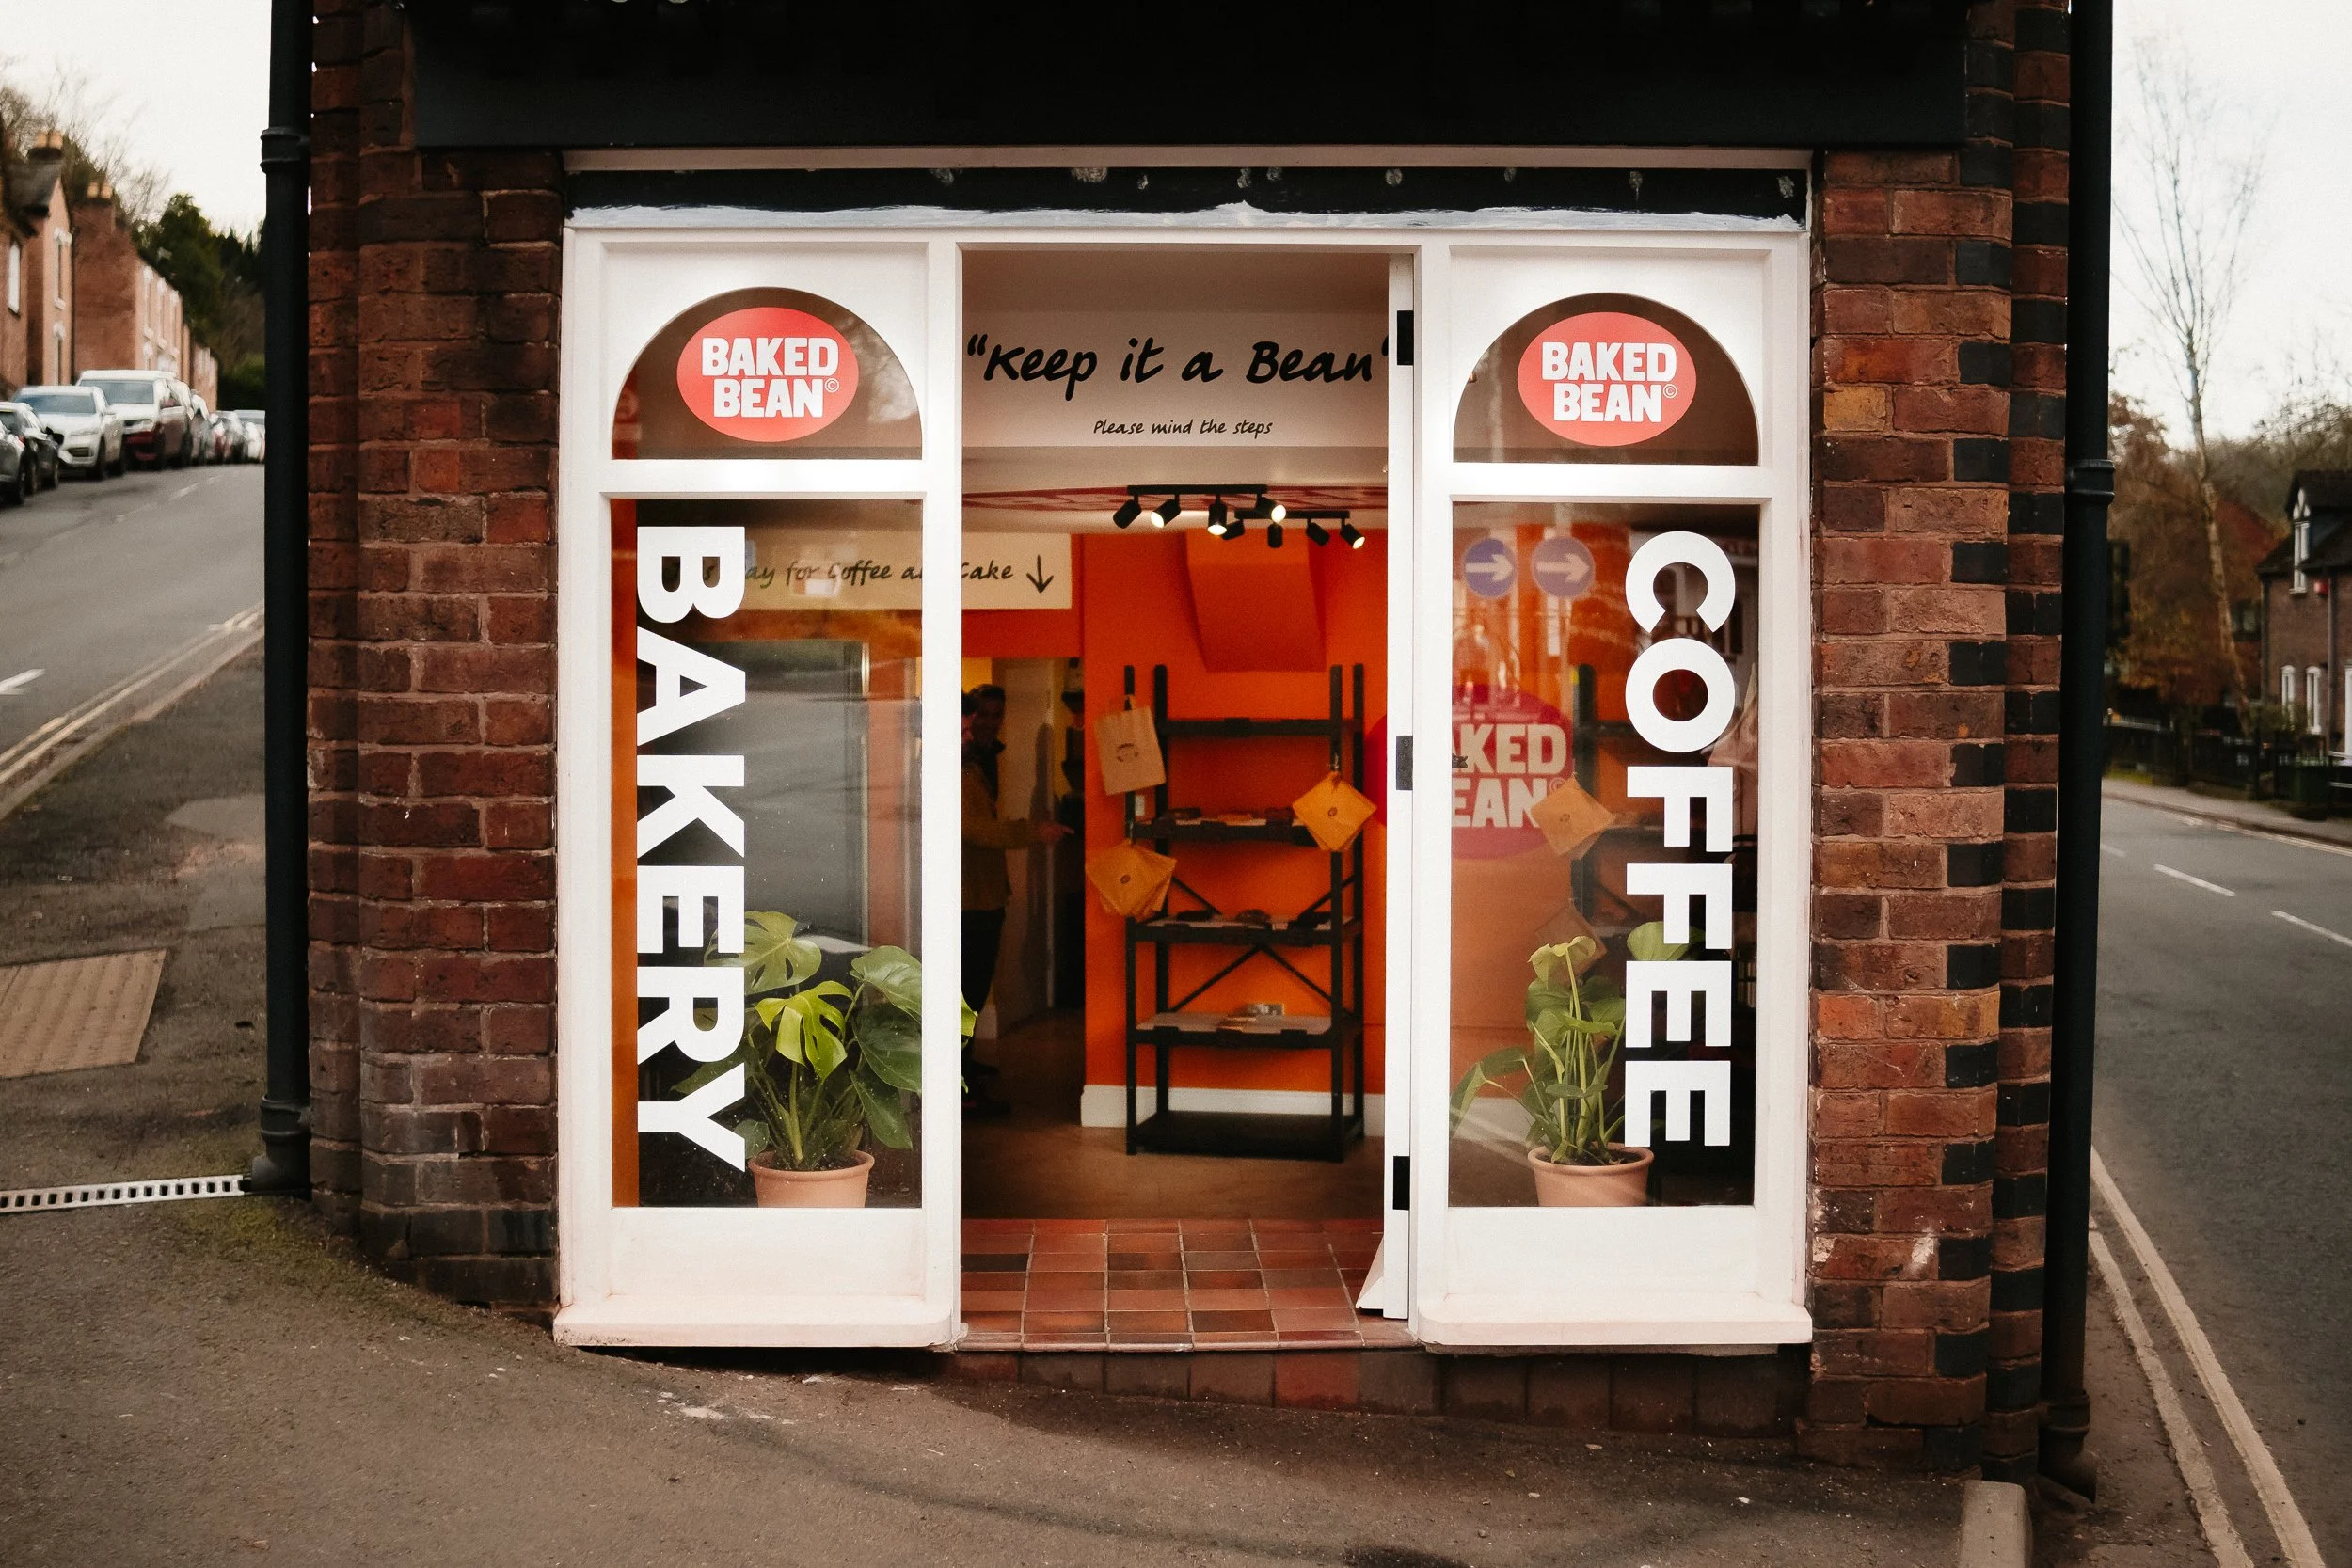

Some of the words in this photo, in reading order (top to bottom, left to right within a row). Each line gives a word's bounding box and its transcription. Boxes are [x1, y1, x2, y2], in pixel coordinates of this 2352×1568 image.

[701, 337, 839, 377] BAKED
[1120, 337, 1165, 384] it
[1181, 347, 1223, 383] a
[1541, 341, 1677, 381] BAKED
[1093, 420, 1145, 436] Please
[1151, 420, 1192, 436] mind
[1200, 420, 1227, 436] the
[1232, 420, 1273, 440] steps
[787, 559, 822, 587] for
[828, 559, 893, 587] Coffee
[1452, 723, 1567, 774] KED
[636, 526, 746, 1173] BAKERY
[1625, 531, 1736, 1148] COFFEE
